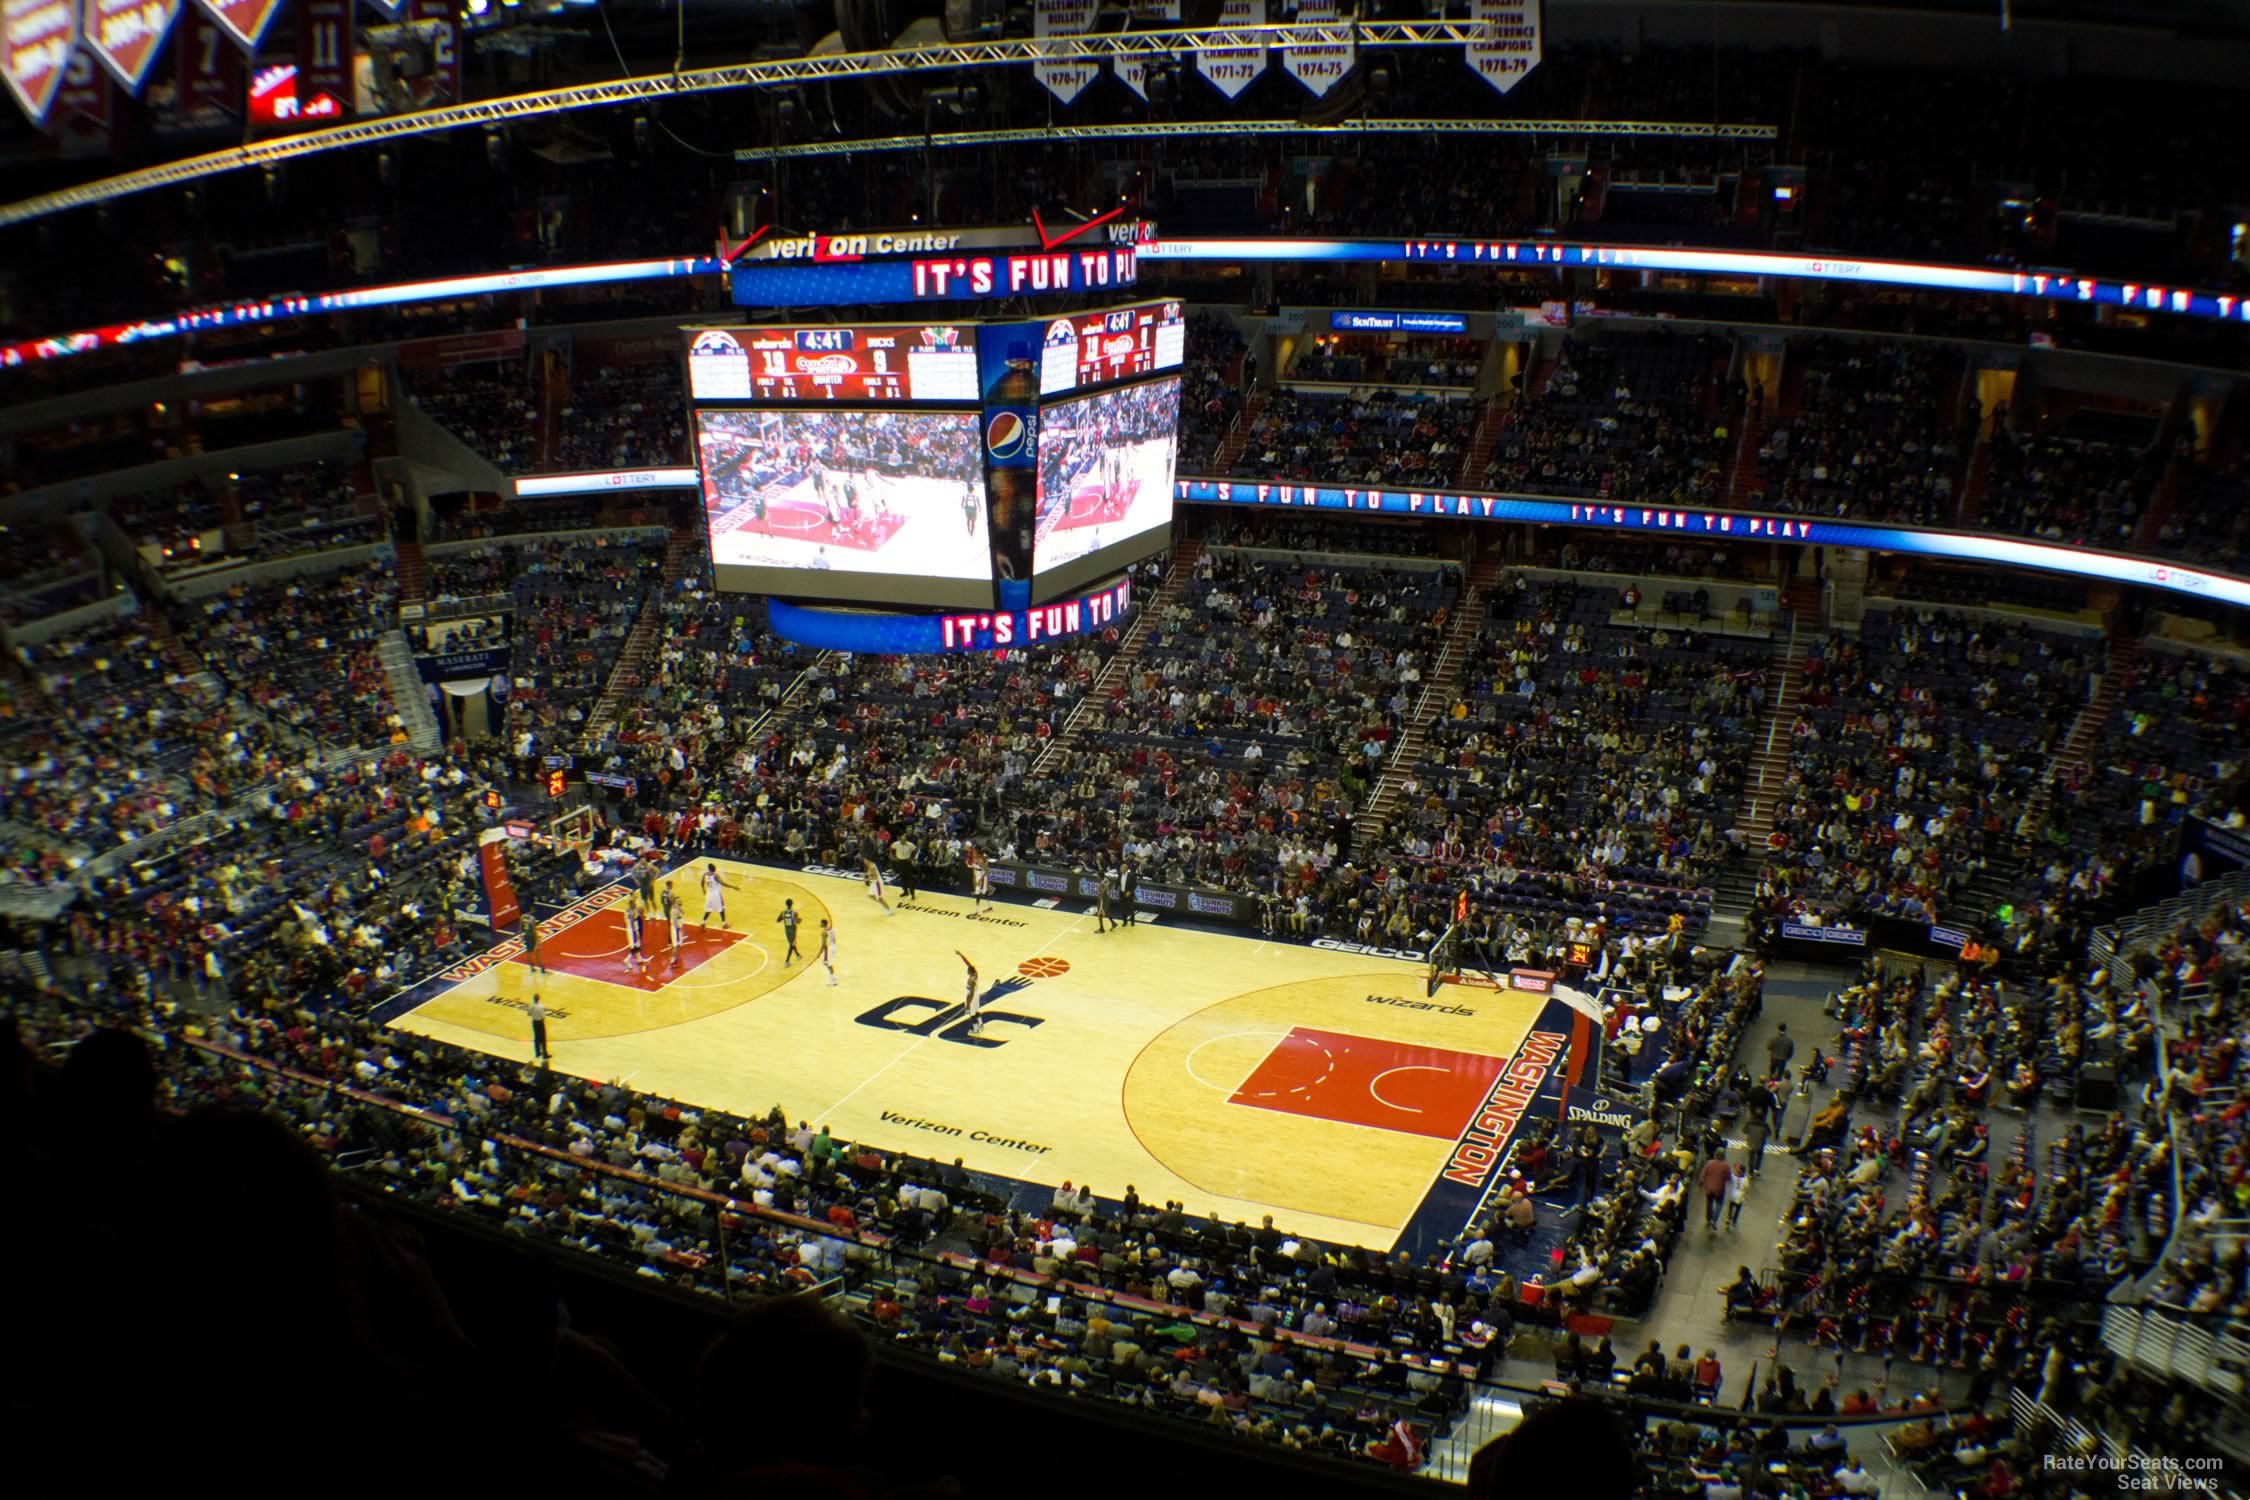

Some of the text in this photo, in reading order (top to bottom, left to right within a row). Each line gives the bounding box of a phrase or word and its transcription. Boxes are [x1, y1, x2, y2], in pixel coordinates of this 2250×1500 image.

[312, 22, 338, 67] 11
[1291, 46, 1347, 56] CHAMPIONS
[1473, 41, 1533, 51] CHAMPIONS
[1209, 65, 1253, 79] 1971-72
[1297, 62, 1342, 77] 1974-75
[1479, 59, 1528, 73] 1978-79
[1046, 72, 1087, 84] 1970-71
[769, 231, 960, 262] verizon Center
[1146, 244, 1193, 254] LOTTERY
[1405, 241, 1456, 258] IT'S
[1475, 243, 1518, 260] FUN
[1536, 244, 1563, 262] TO
[913, 260, 993, 297] IT'S
[1009, 254, 1070, 292] FUN
[1080, 251, 1109, 287] TO
[2013, 273, 2096, 299] IT'S
[2122, 285, 2192, 311] FUN
[805, 331, 842, 350] 4:41
[867, 337, 895, 348] BUCKS
[873, 350, 888, 374] 9
[813, 375, 843, 386] QUARTER
[1025, 414, 1037, 458] pepsi
[605, 474, 657, 484] LOTTERY
[1258, 485, 1315, 506] FUN
[1345, 489, 1381, 509] TO
[1410, 493, 1495, 516] PLAY
[1572, 505, 1811, 538] IT'S FUN TO PLAY
[941, 614, 1013, 648] IT'S
[1027, 600, 1080, 640] FUN
[1089, 593, 1112, 626] TO
[436, 653, 489, 666] MASERATI
[550, 779, 563, 796] 24
[1036, 875, 1068, 886] DUNKIN'
[1037, 882, 1068, 892] DONUTS
[1144, 889, 1177, 901] DUNKIN'
[1144, 896, 1176, 908] DONUTS
[1201, 898, 1233, 908] DUNKIN'
[1201, 904, 1233, 915] DONUTS
[896, 902, 1029, 928] Verizon Center
[440, 884, 633, 982] WASHNGTON
[1785, 926, 1822, 937] GEICO
[1827, 931, 1864, 941] GEICO
[1311, 937, 1426, 961] GEICO
[1573, 952, 1586, 962] 24
[1366, 994, 1477, 1017] wizards
[1443, 1030, 1567, 1187] WASHINGTON
[1568, 1106, 1632, 1129] SPALDING
[880, 1111, 1053, 1154] Verizon Center
